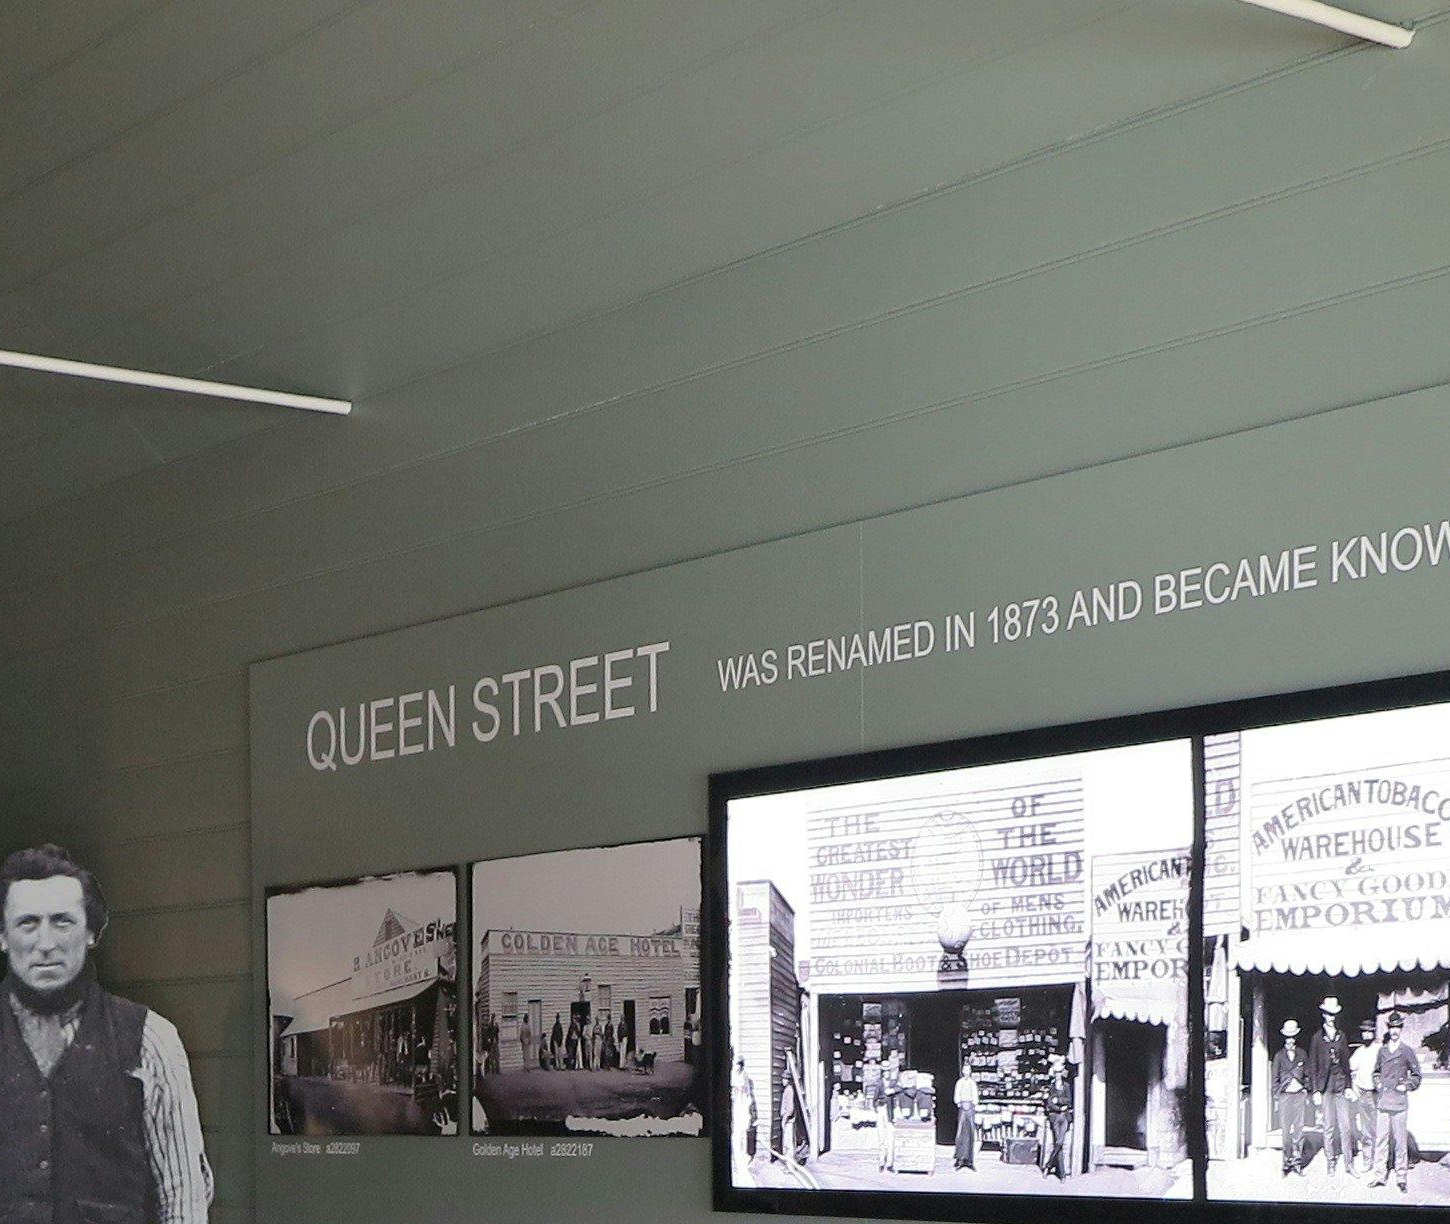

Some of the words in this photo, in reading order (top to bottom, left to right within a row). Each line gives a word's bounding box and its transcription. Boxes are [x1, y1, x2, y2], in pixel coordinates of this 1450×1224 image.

[718, 649, 778, 692] WAS
[787, 619, 935, 680] RENAMED
[945, 612, 975, 652] IN
[986, 596, 1059, 643] 1873
[1067, 579, 1143, 631] AND
[1153, 545, 1318, 615] BECAME
[306, 684, 455, 771] QUEEN
[471, 641, 670, 742] STREET
[1011, 795, 1044, 817] OF
[824, 813, 879, 838] THE
[998, 823, 1056, 849] THE
[816, 838, 914, 866] GREATEST
[1281, 822, 1442, 862] WAREHOUSE
[991, 852, 1084, 888] WORLD
[811, 867, 905, 902] WONDER
[1255, 879, 1346, 903] FANCY
[981, 902, 1001, 915] OF
[1011, 892, 1065, 912] MENS
[630, 938, 681, 957] HOTEL
[814, 957, 886, 975] COLONIAL
[1005, 946, 1074, 969] DEPOT
[1095, 940, 1167, 959] FANCY
[473, 1142, 501, 1156] Golden
[503, 1143, 519, 1159] Age
[521, 1142, 544, 1157] Hotel
